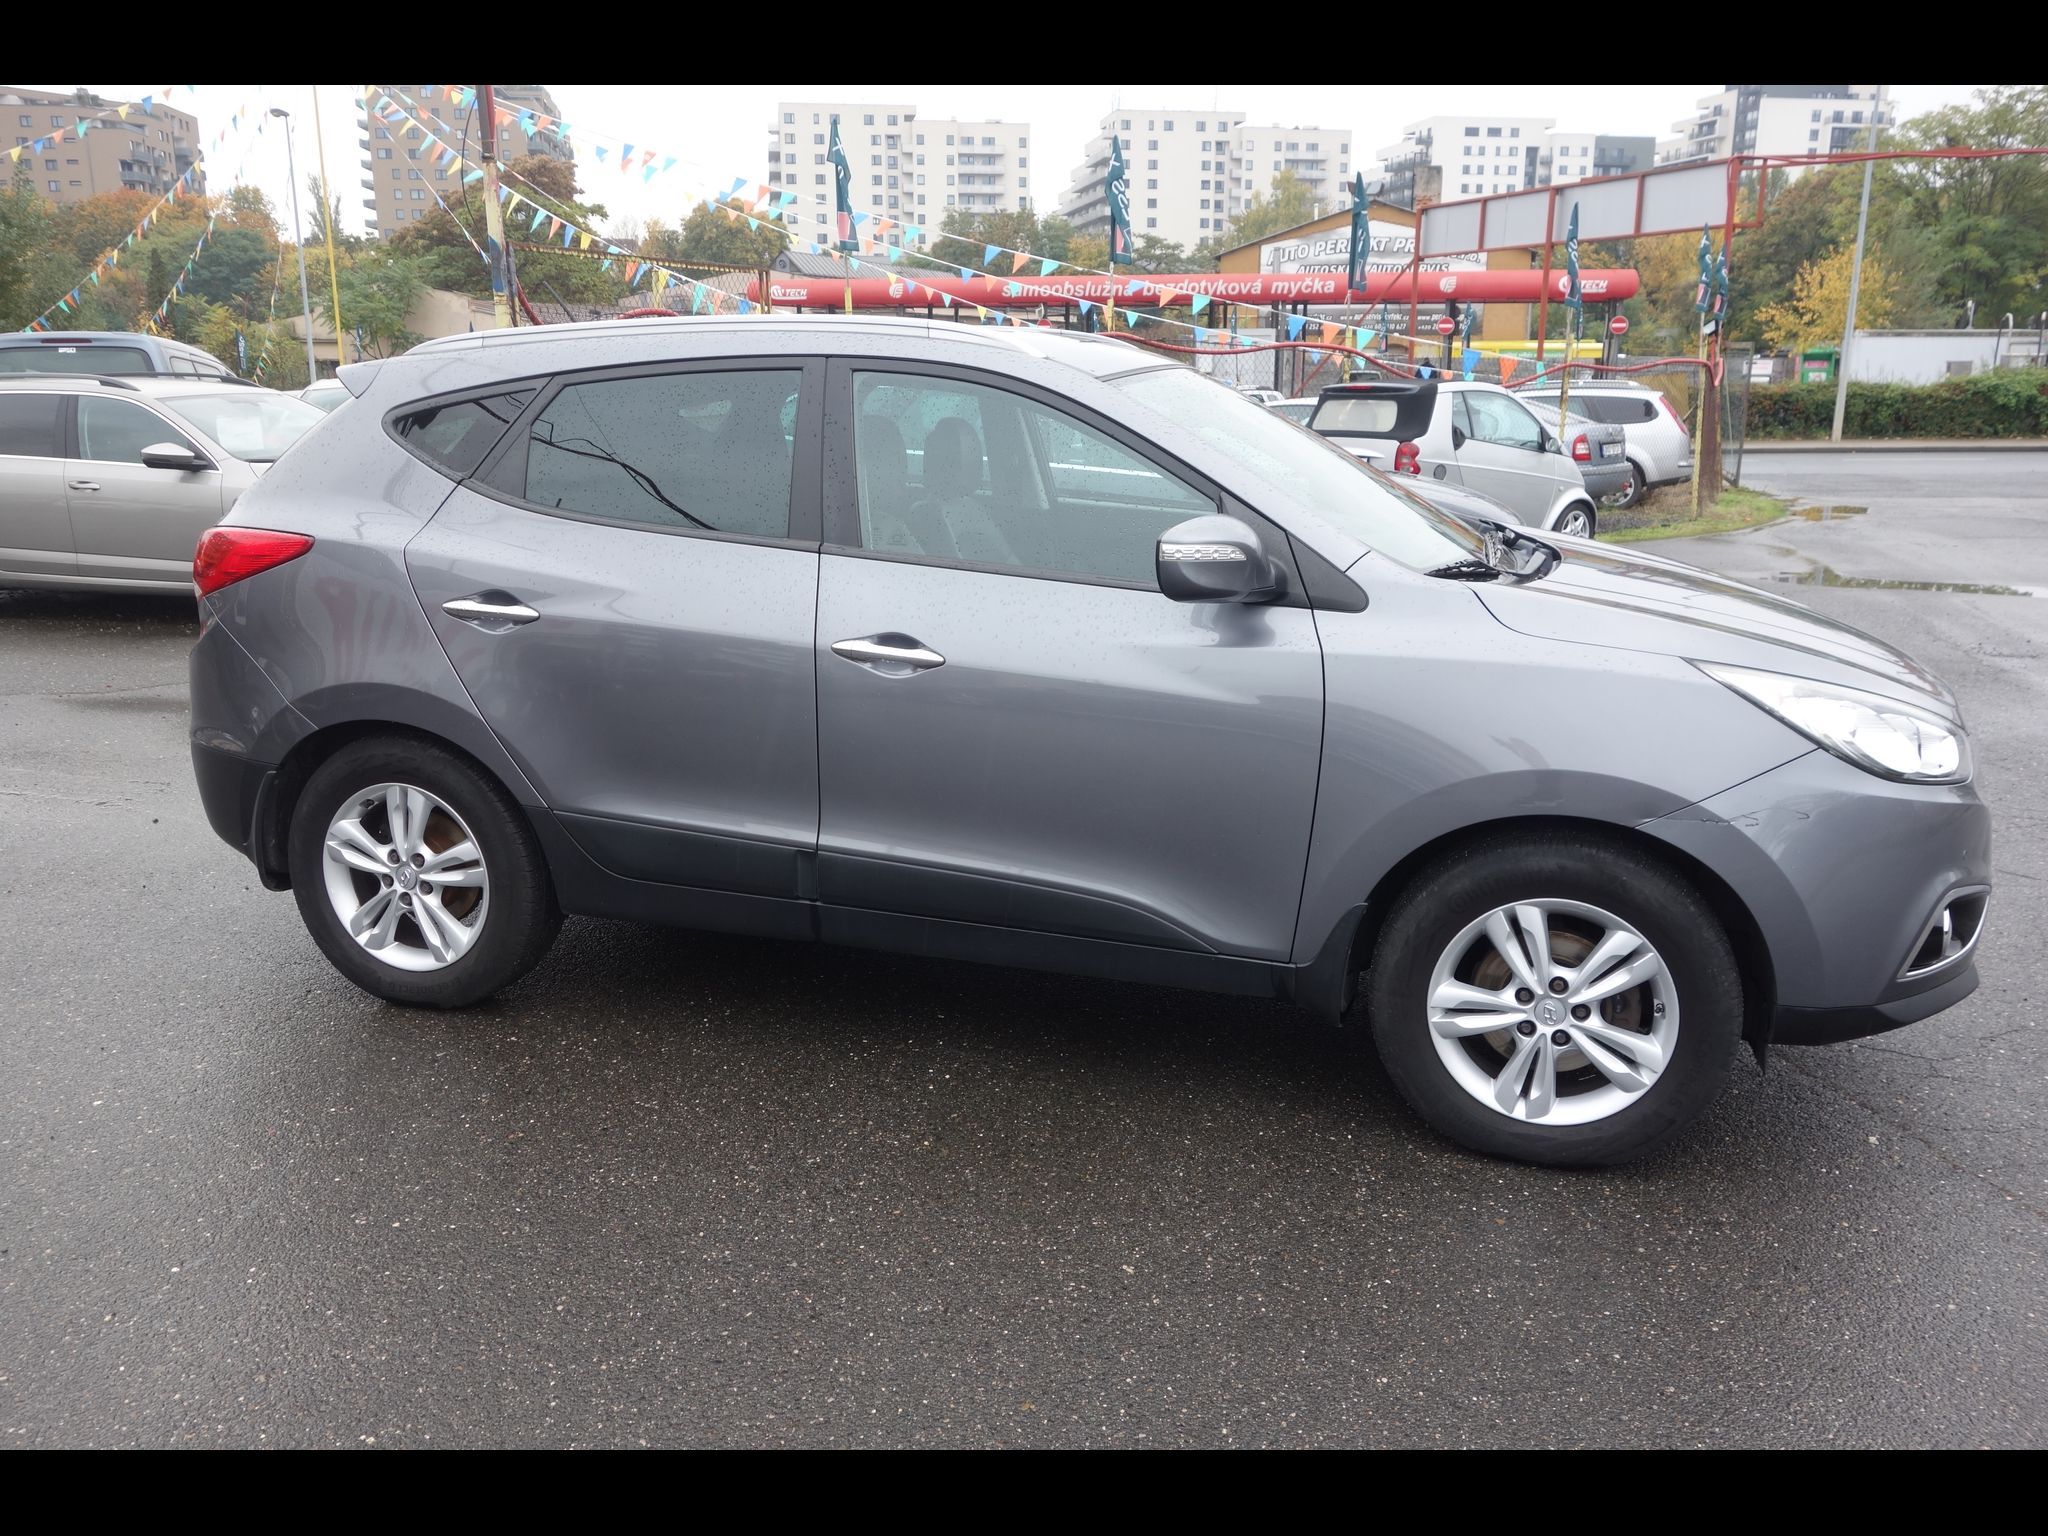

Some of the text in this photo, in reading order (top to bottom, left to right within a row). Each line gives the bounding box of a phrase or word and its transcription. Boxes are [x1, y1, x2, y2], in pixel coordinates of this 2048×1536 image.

[1313, 236, 1391, 257] PERKT
[1369, 263, 1449, 273] AUTORVIS
[1001, 281, 1134, 297] smoobslužn
[1271, 277, 1336, 298] myčka
